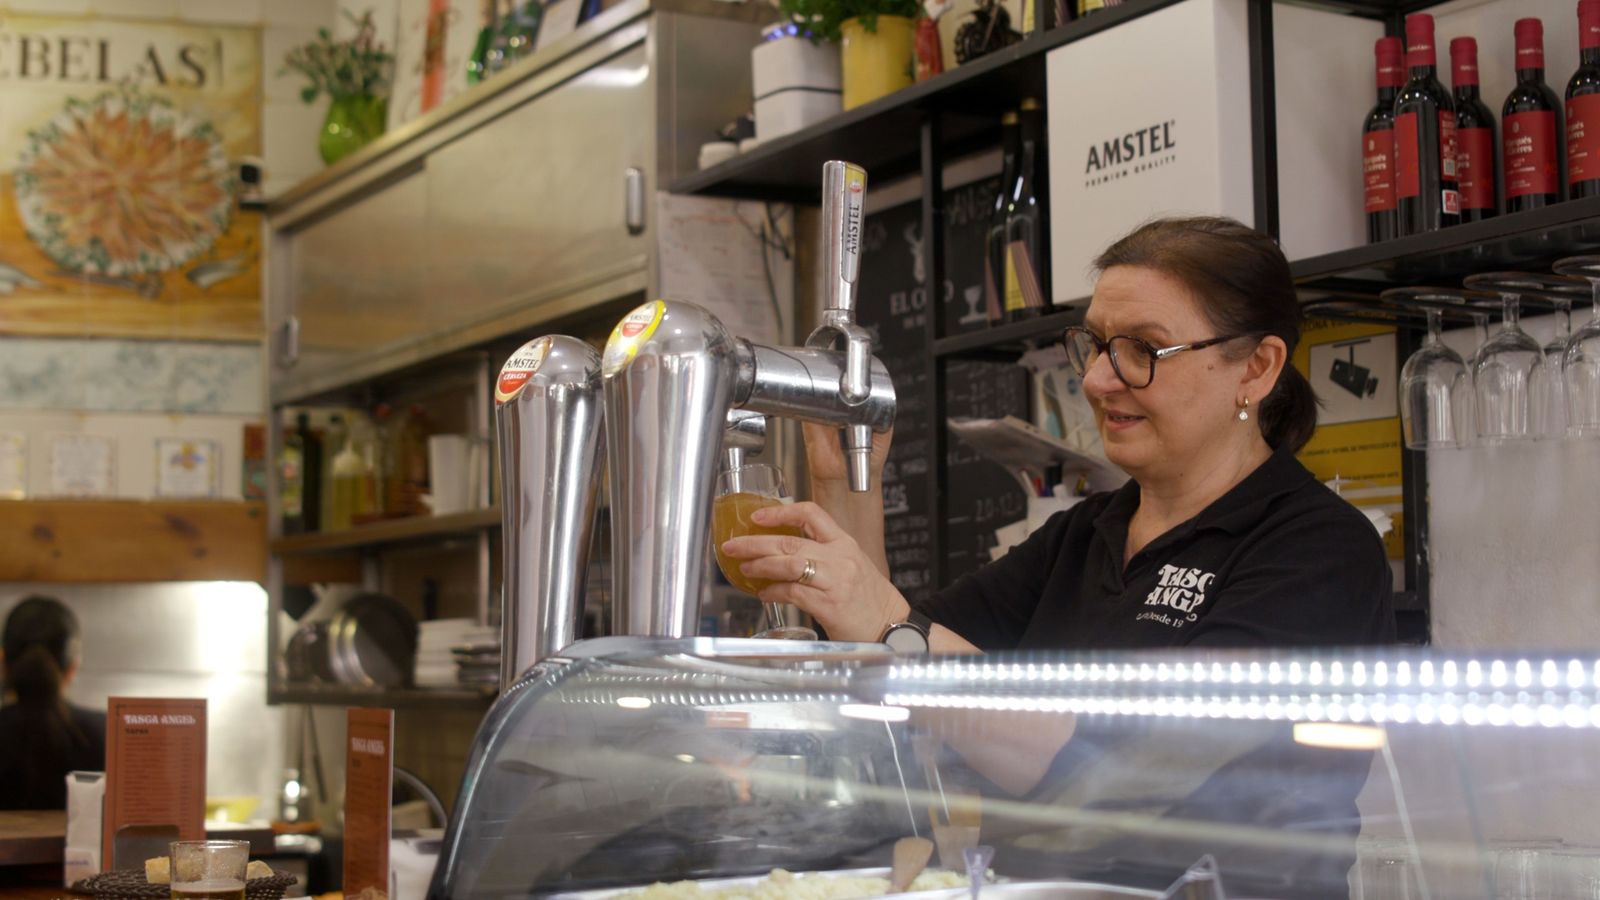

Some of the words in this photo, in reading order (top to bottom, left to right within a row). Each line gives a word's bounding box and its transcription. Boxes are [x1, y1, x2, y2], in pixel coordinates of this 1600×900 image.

[1085, 121, 1175, 174] AMSTEL
[1085, 169, 1128, 188] PREMIUM
[1134, 155, 1176, 173] QUALITY
[846, 204, 860, 255] AMSTEL
[505, 358, 540, 369] AMSTEL
[1158, 564, 1216, 593] TASC
